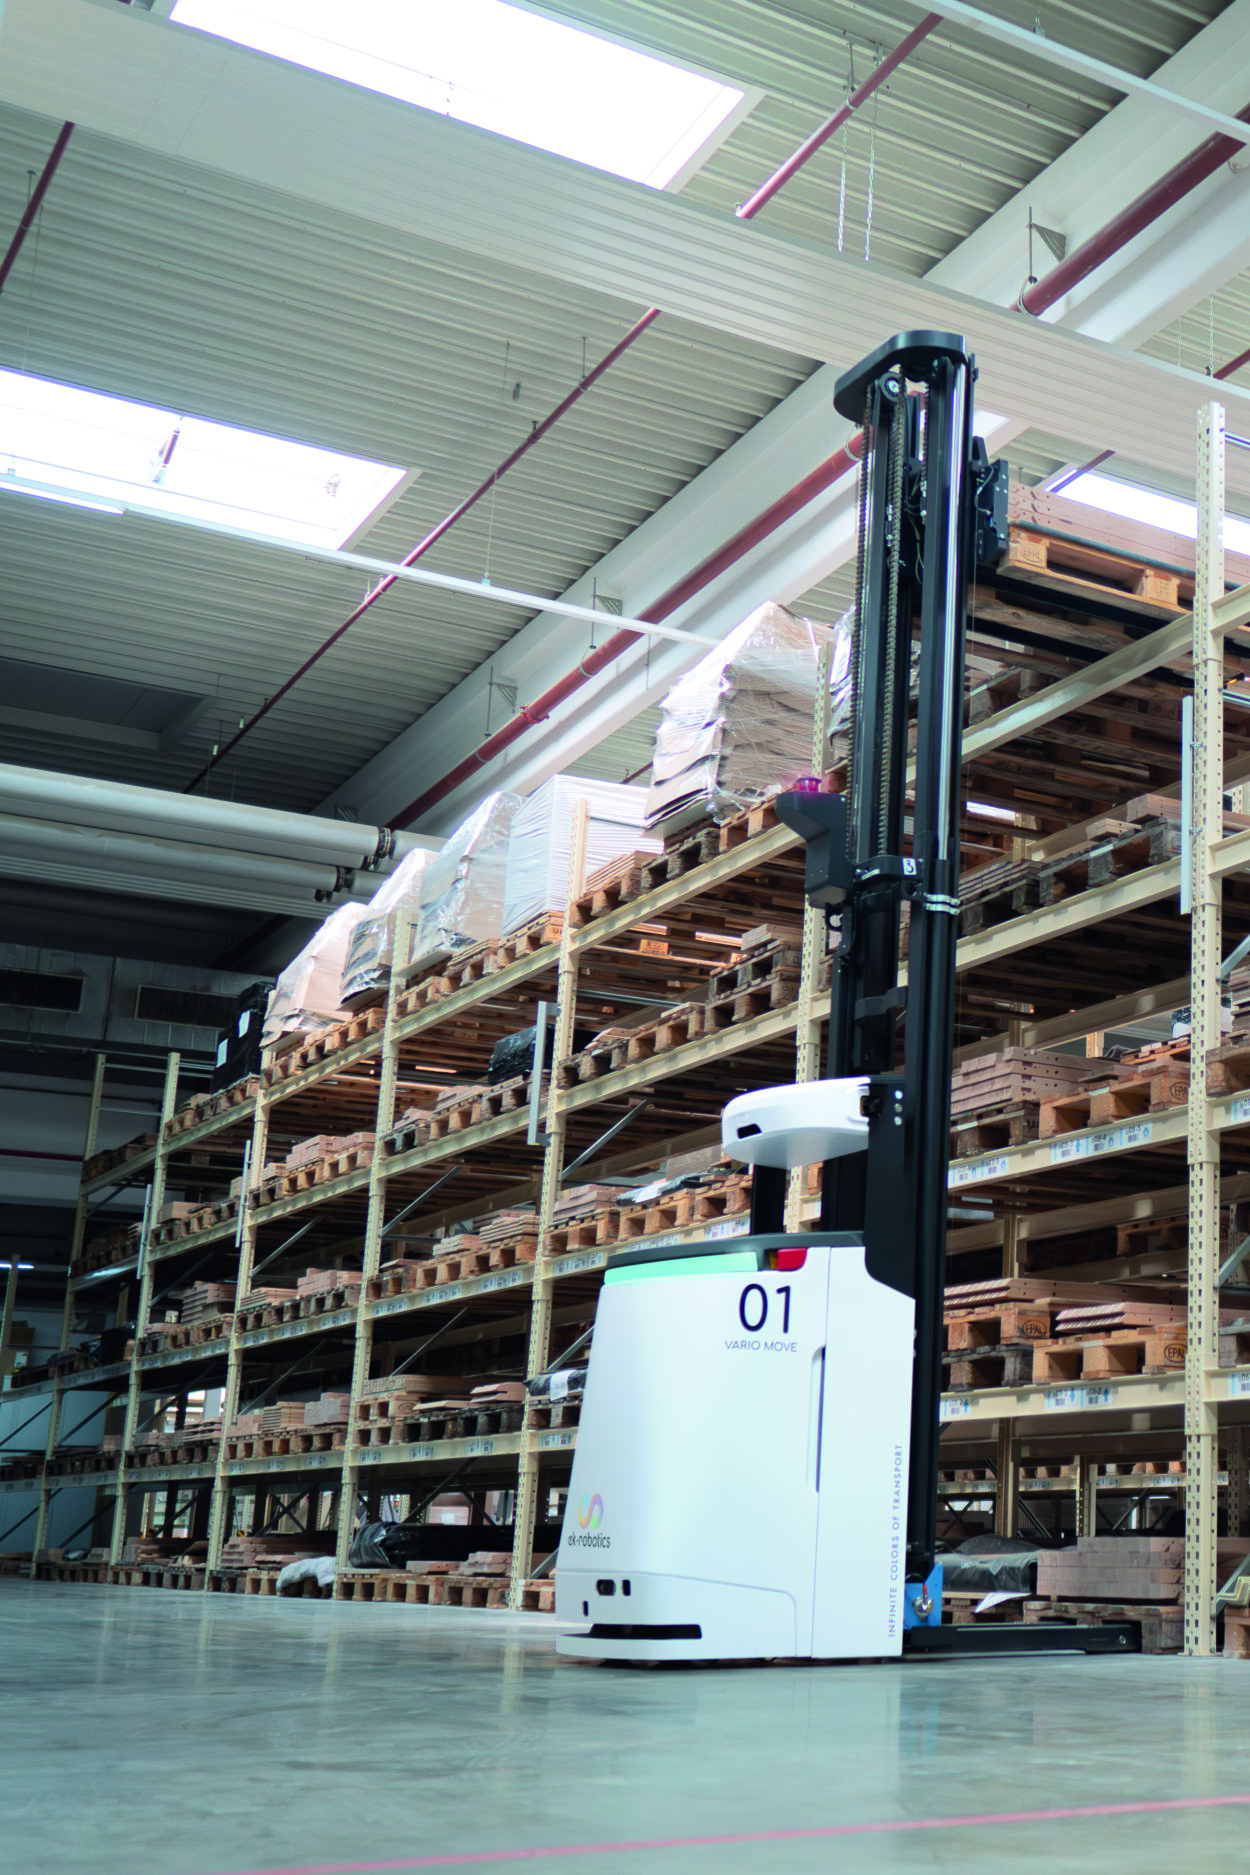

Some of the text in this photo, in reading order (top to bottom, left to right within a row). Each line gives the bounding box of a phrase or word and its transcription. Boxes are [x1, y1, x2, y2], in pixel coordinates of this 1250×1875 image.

[738, 1283, 791, 1334] 01
[724, 1340, 798, 1353] VARIO MOVE
[568, 1531, 611, 1548] ek-robotics
[888, 1444, 903, 1637] INFINITE COLORS OF TRANSPORT
